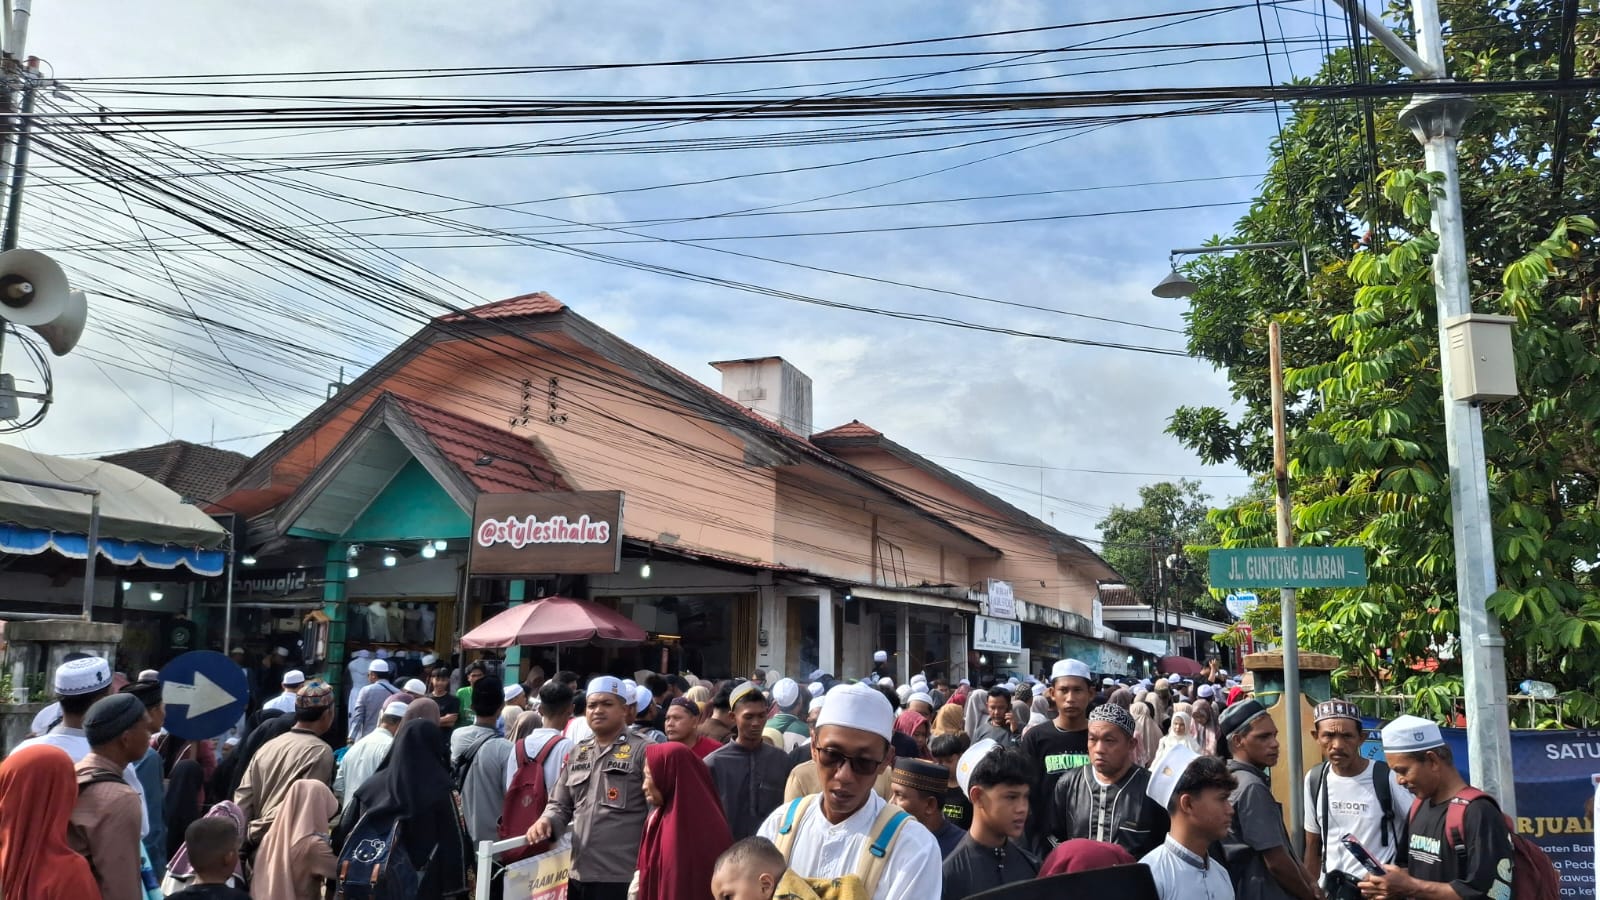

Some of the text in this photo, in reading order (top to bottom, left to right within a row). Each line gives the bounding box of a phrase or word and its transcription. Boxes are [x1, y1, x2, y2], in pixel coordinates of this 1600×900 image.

[479, 515, 609, 548] @stylesihalus
[1228, 555, 1345, 580] JL. GUNTUNG ALABAN
[607, 760, 630, 769] POLRI
